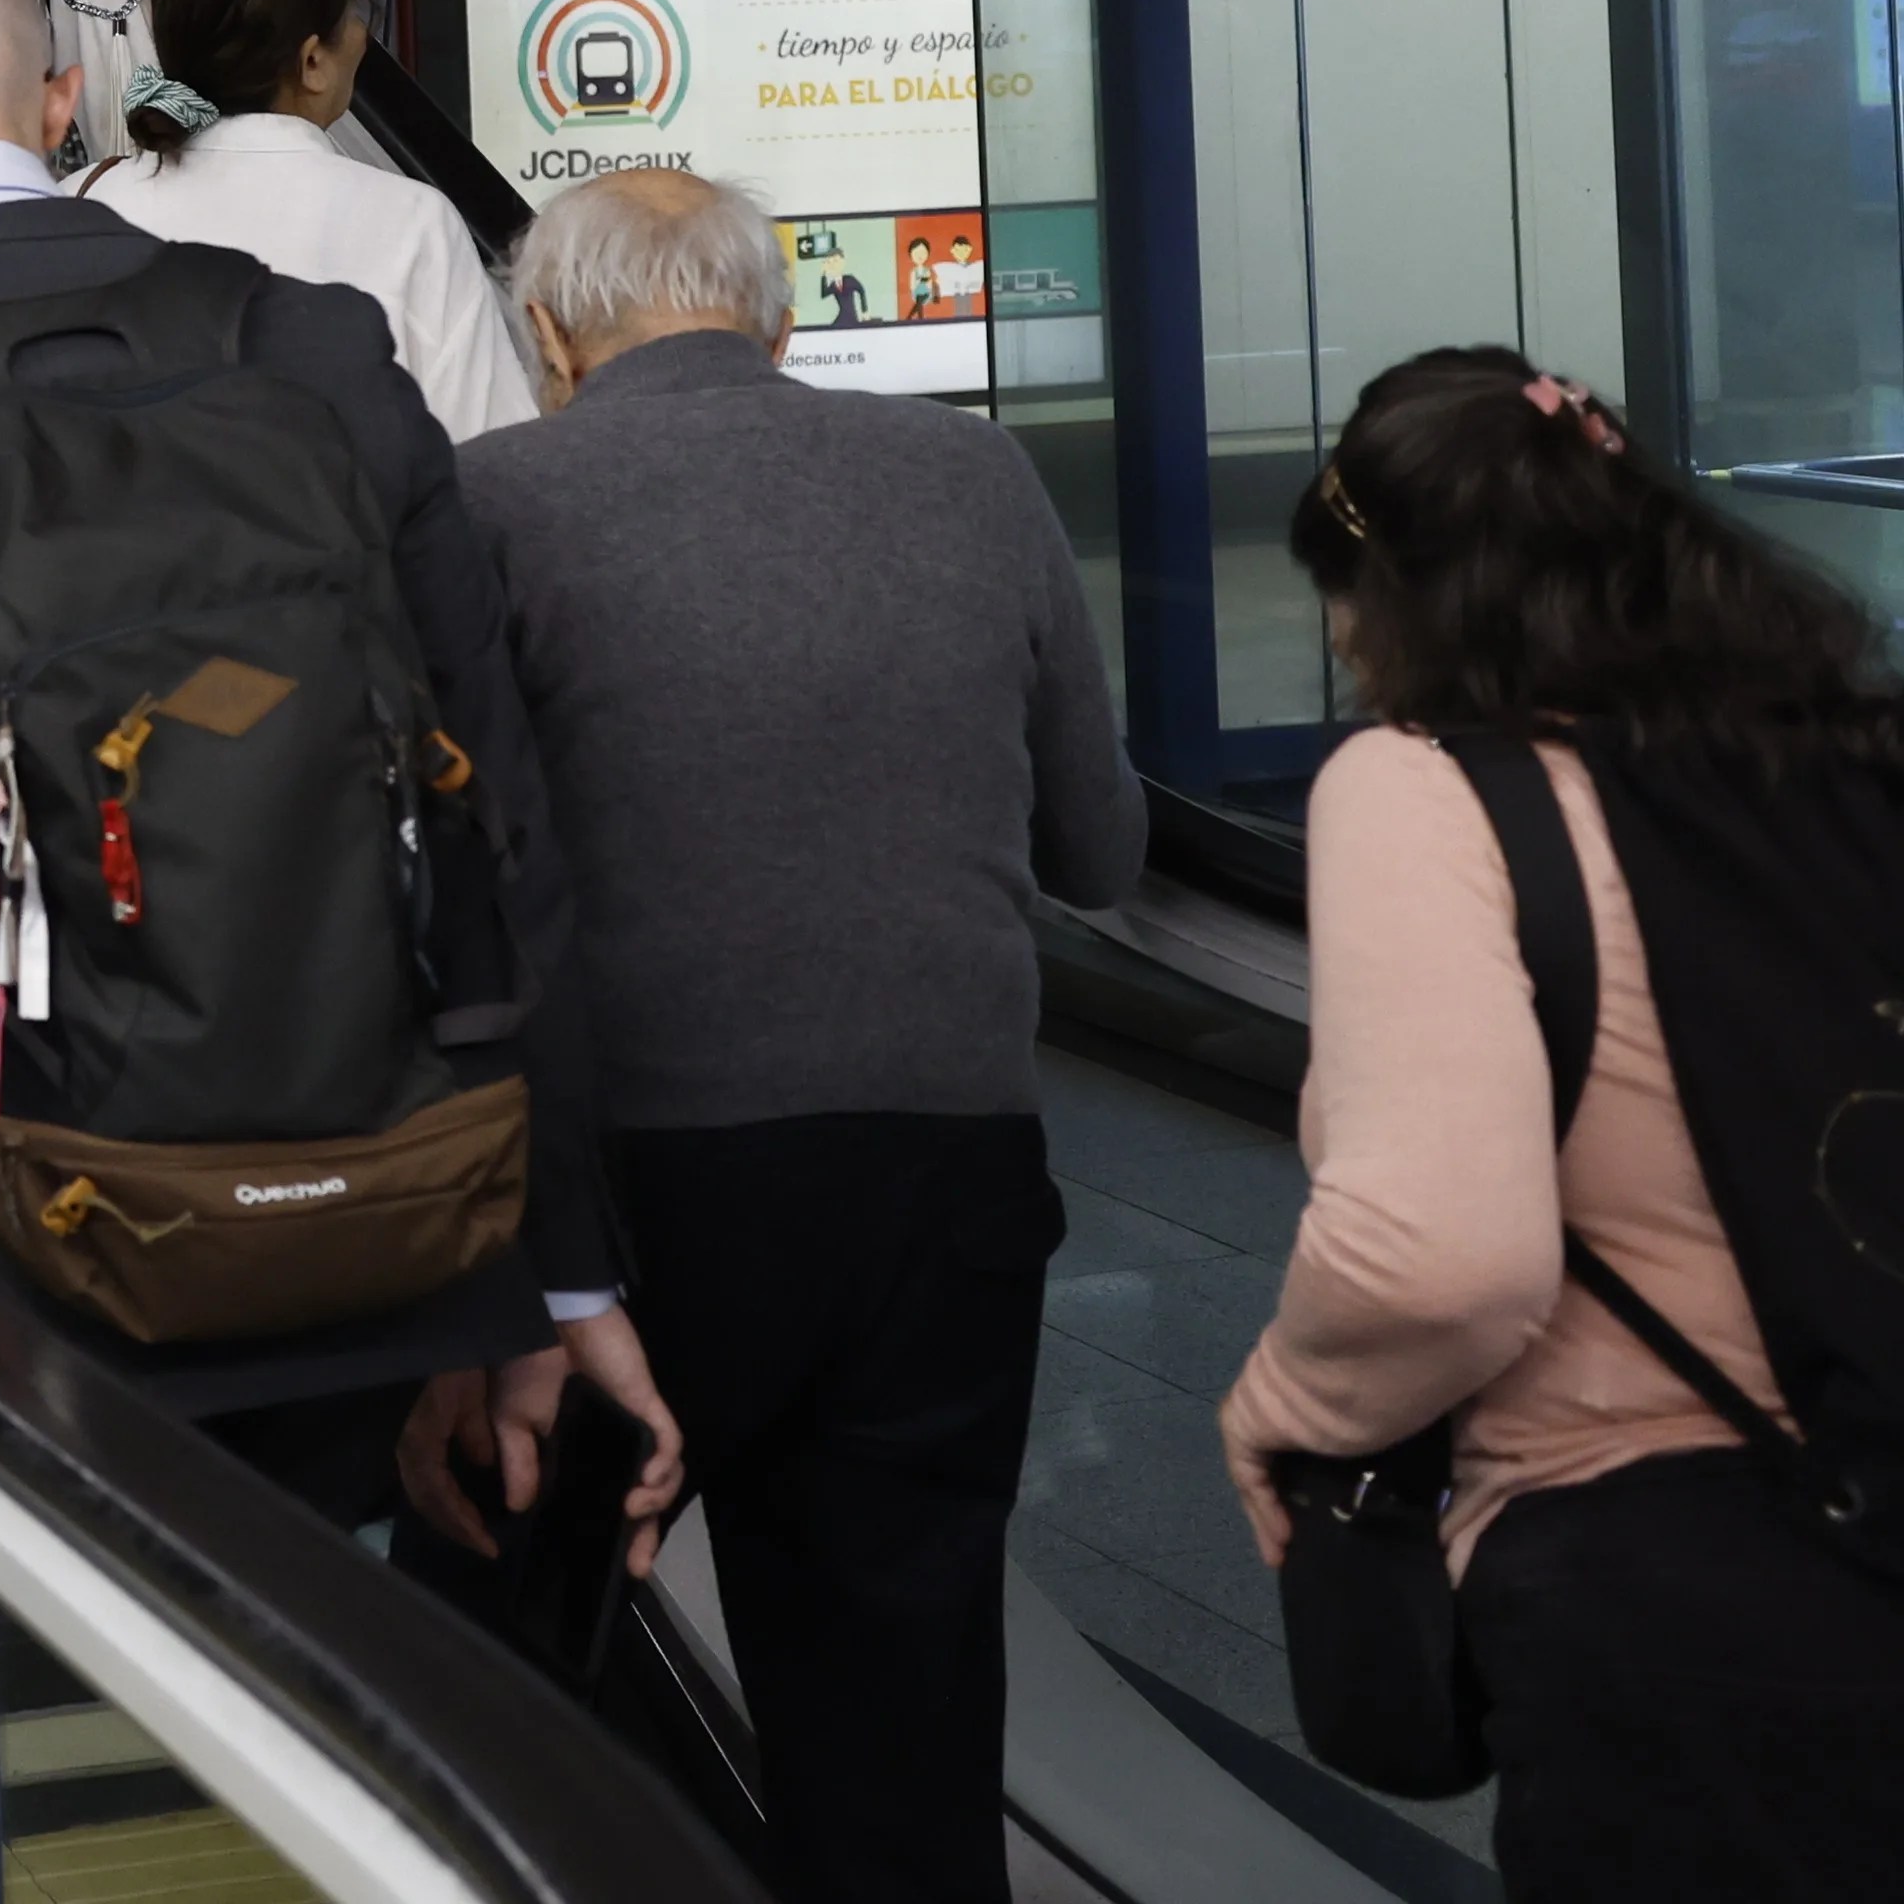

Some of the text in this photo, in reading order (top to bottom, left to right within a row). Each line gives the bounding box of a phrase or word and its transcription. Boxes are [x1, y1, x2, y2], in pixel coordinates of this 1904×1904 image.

[777, 28, 876, 66] tiempo
[883, 34, 901, 64] y
[759, 81, 840, 108] PARA
[849, 80, 884, 104] EL
[235, 1177, 346, 1206] Quechua
